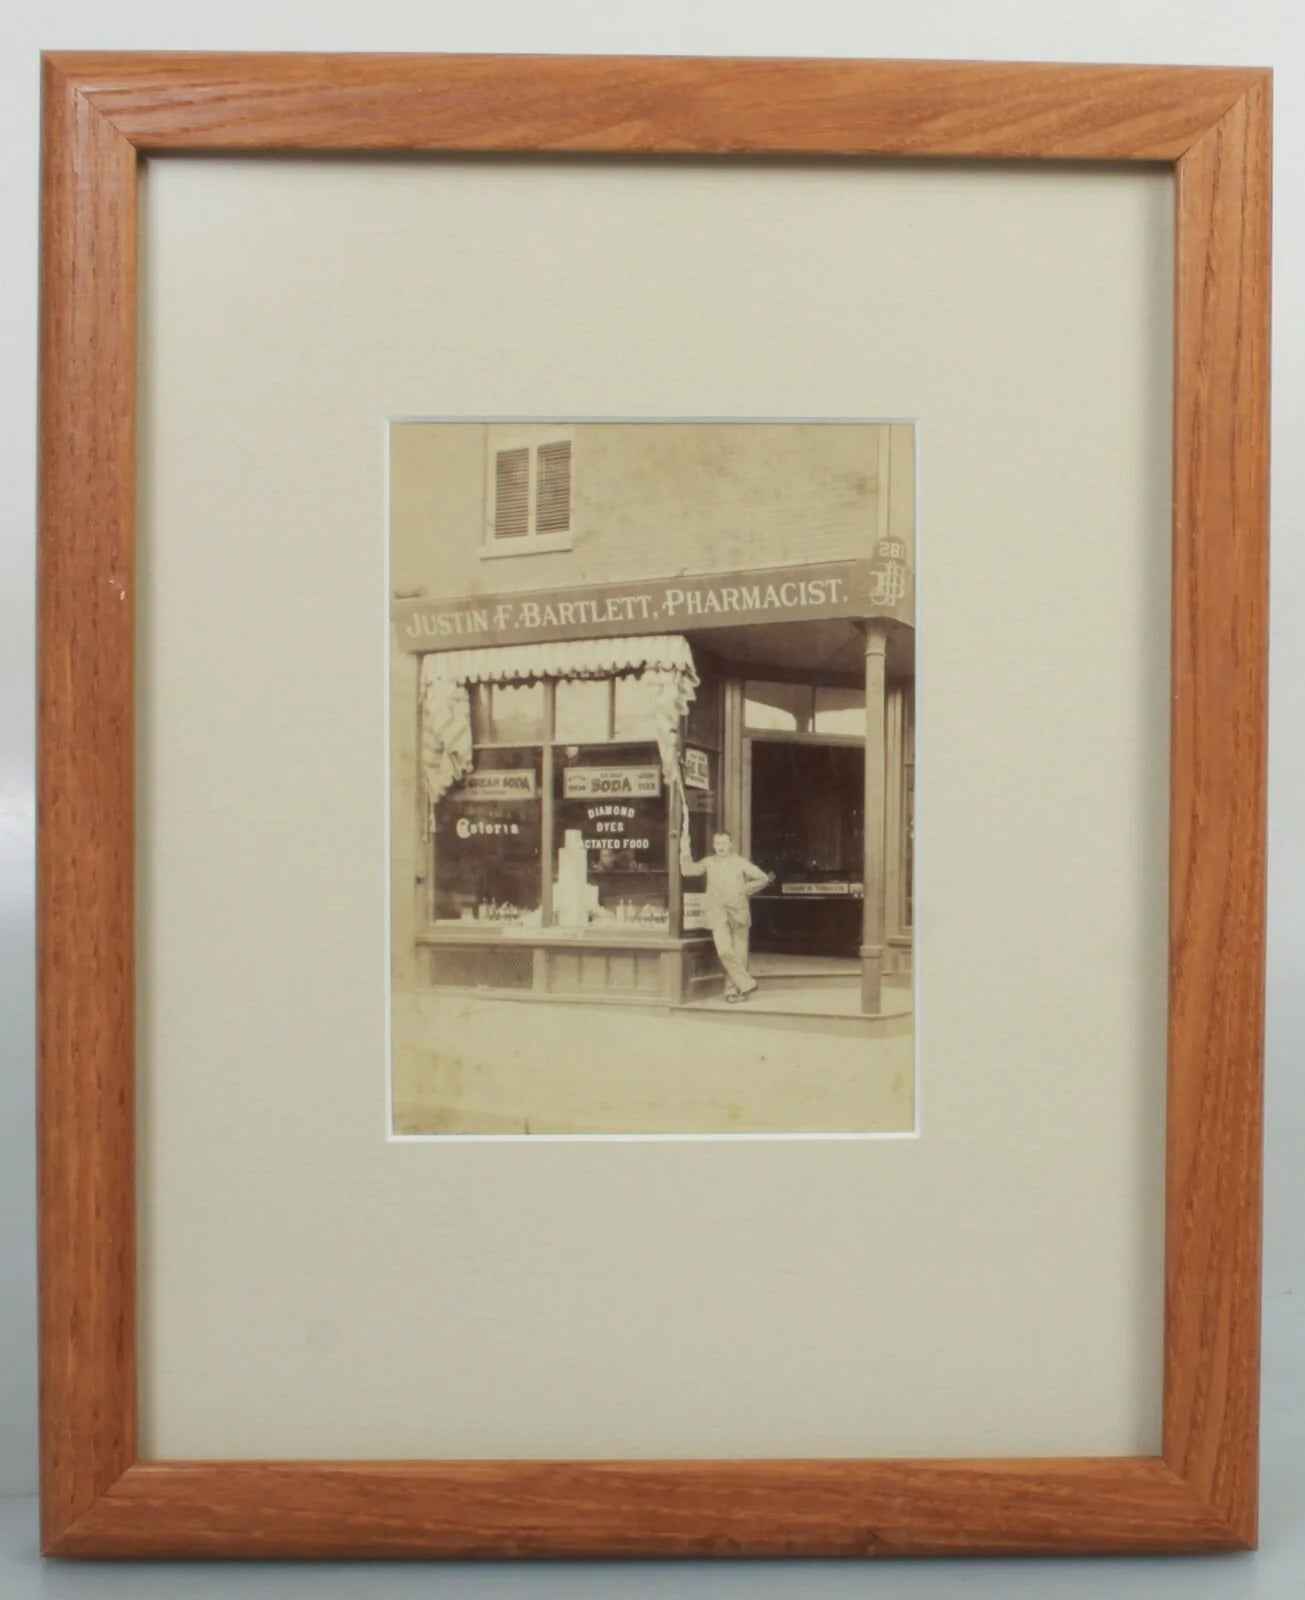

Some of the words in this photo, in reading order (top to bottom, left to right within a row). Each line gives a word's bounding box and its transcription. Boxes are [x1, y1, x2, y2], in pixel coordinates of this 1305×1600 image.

[406, 609, 488, 638] JUSTIN
[494, 604, 519, 631] F.
[520, 595, 659, 628] BARTLETT,
[662, 578, 849, 617] PHARMACIST.
[591, 777, 632, 793] SODA
[587, 805, 635, 819] DIAMOND
[596, 822, 624, 832] DYES
[623, 839, 649, 849] FOOD
